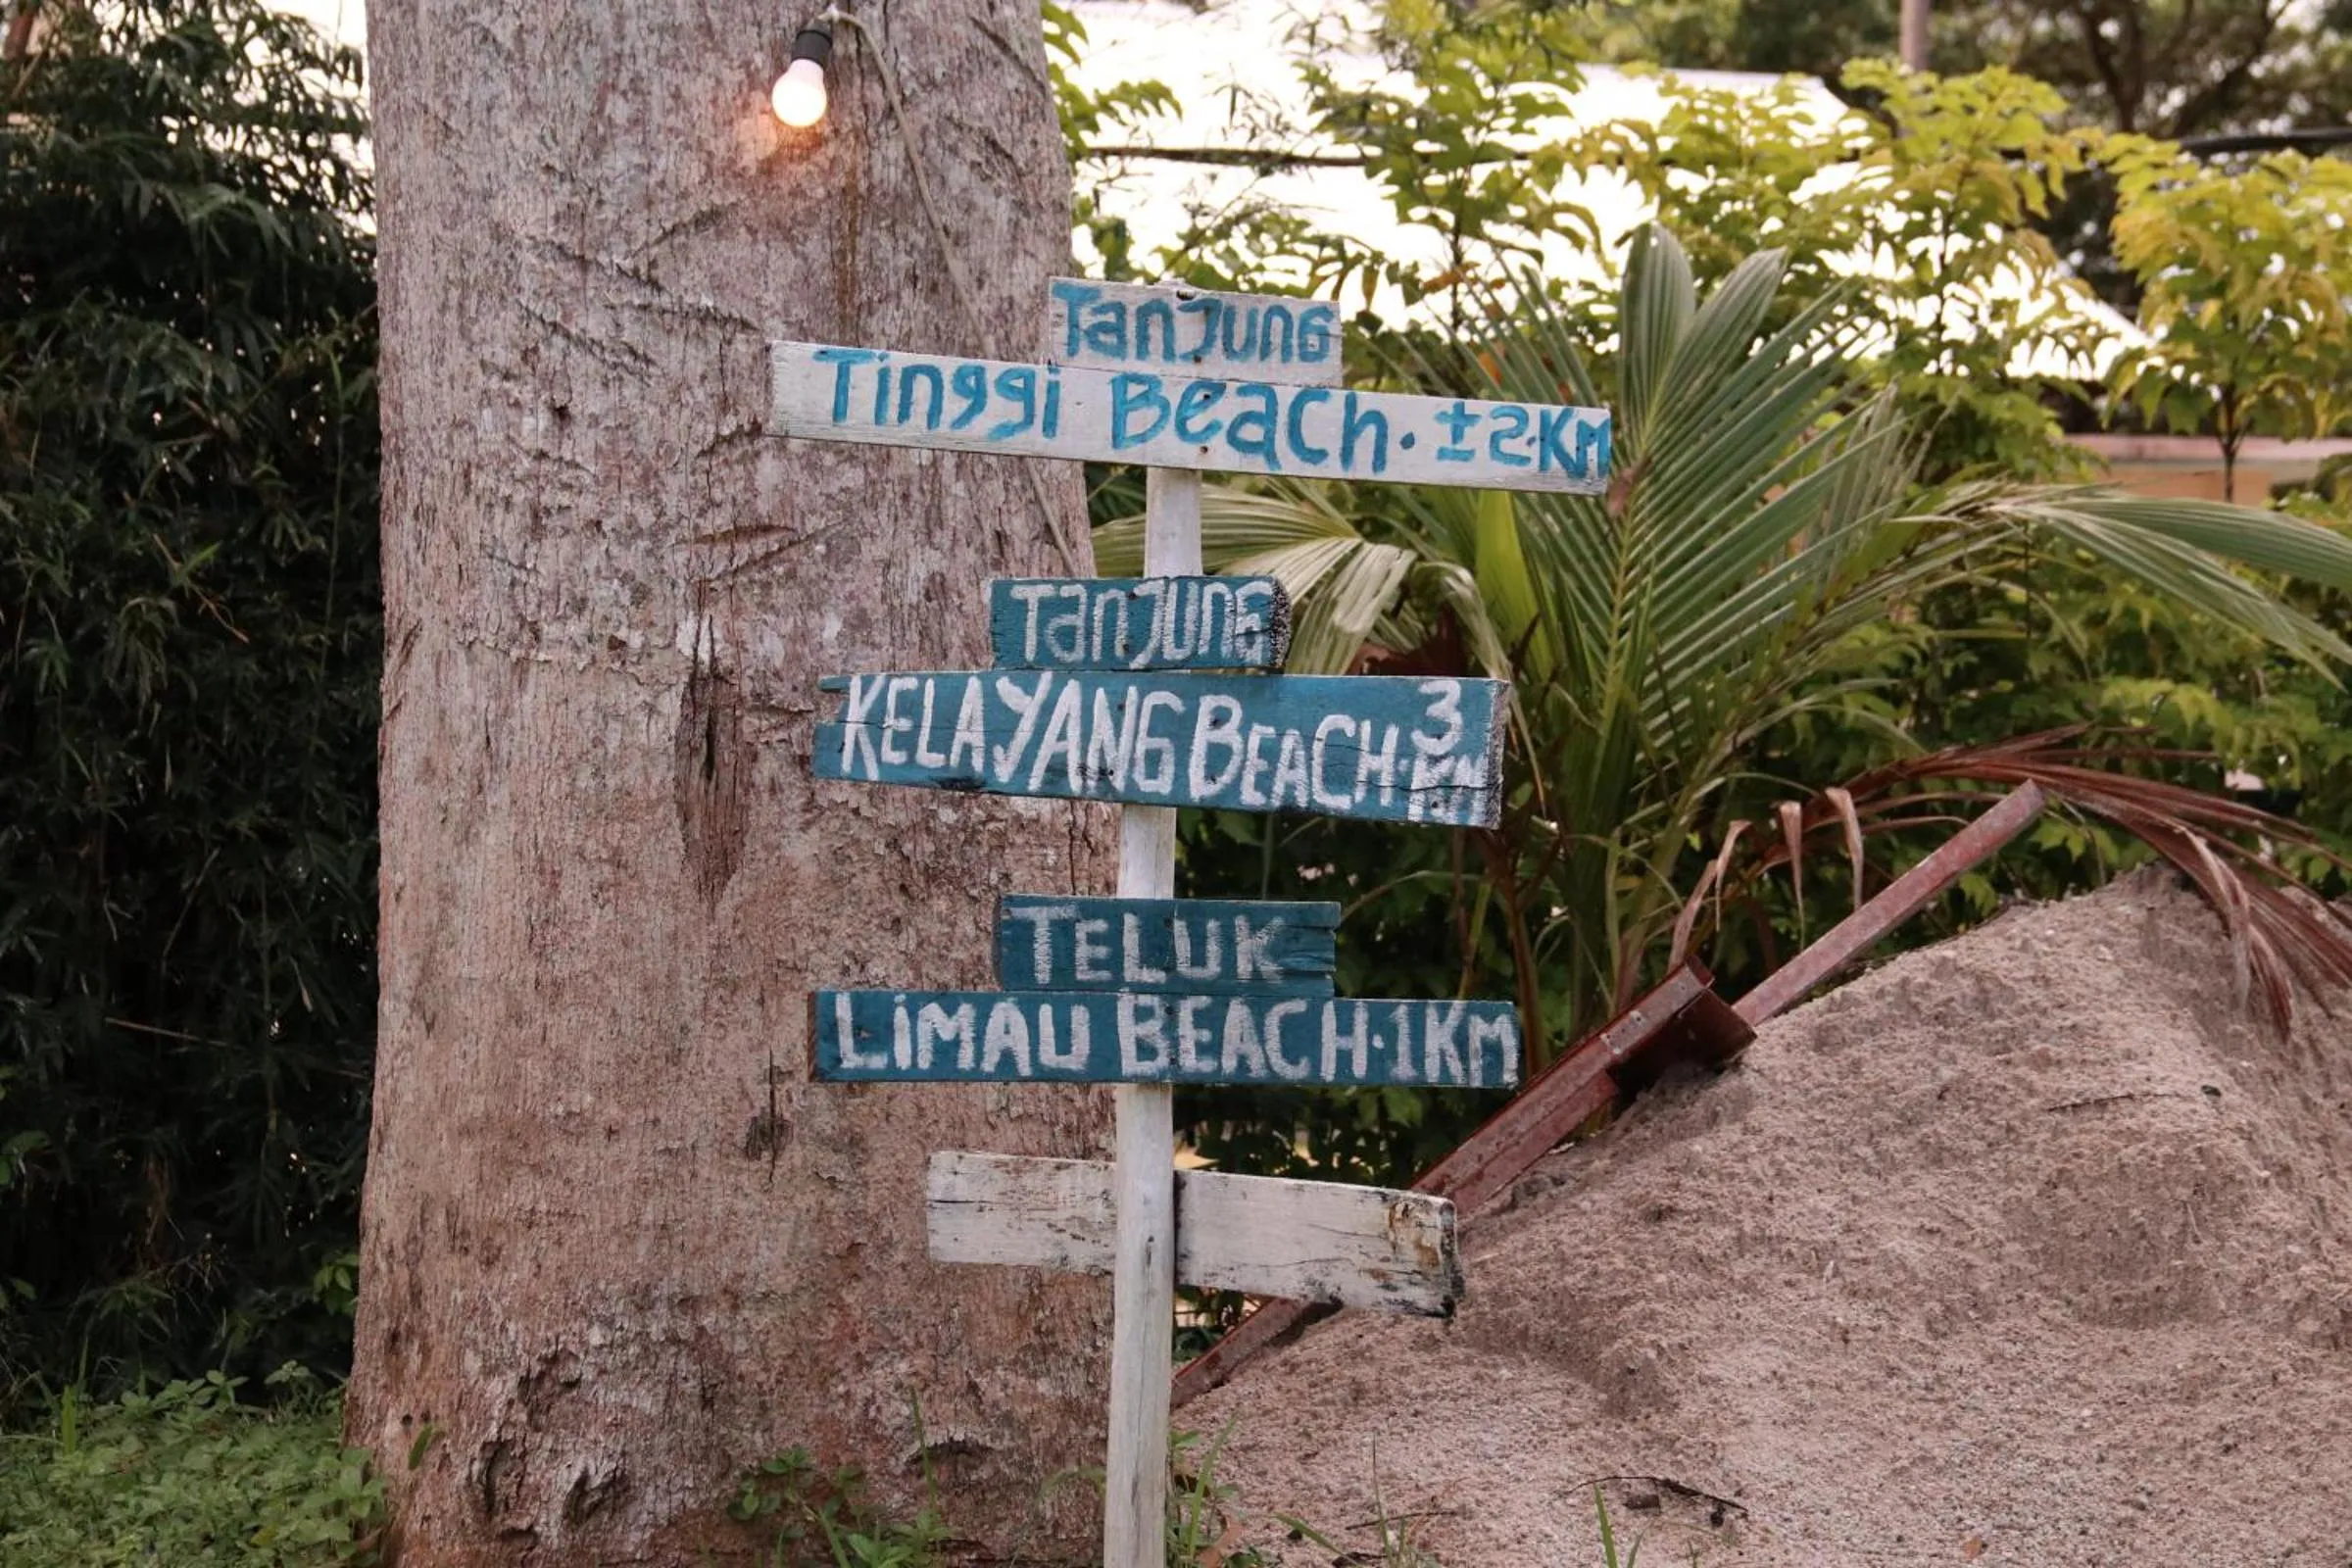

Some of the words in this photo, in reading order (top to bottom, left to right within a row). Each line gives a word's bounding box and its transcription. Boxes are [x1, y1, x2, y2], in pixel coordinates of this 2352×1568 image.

[812, 348, 1061, 440] Tinggi
[841, 670, 1185, 796] KELAYANG
[1005, 905, 1285, 985] TELUK
